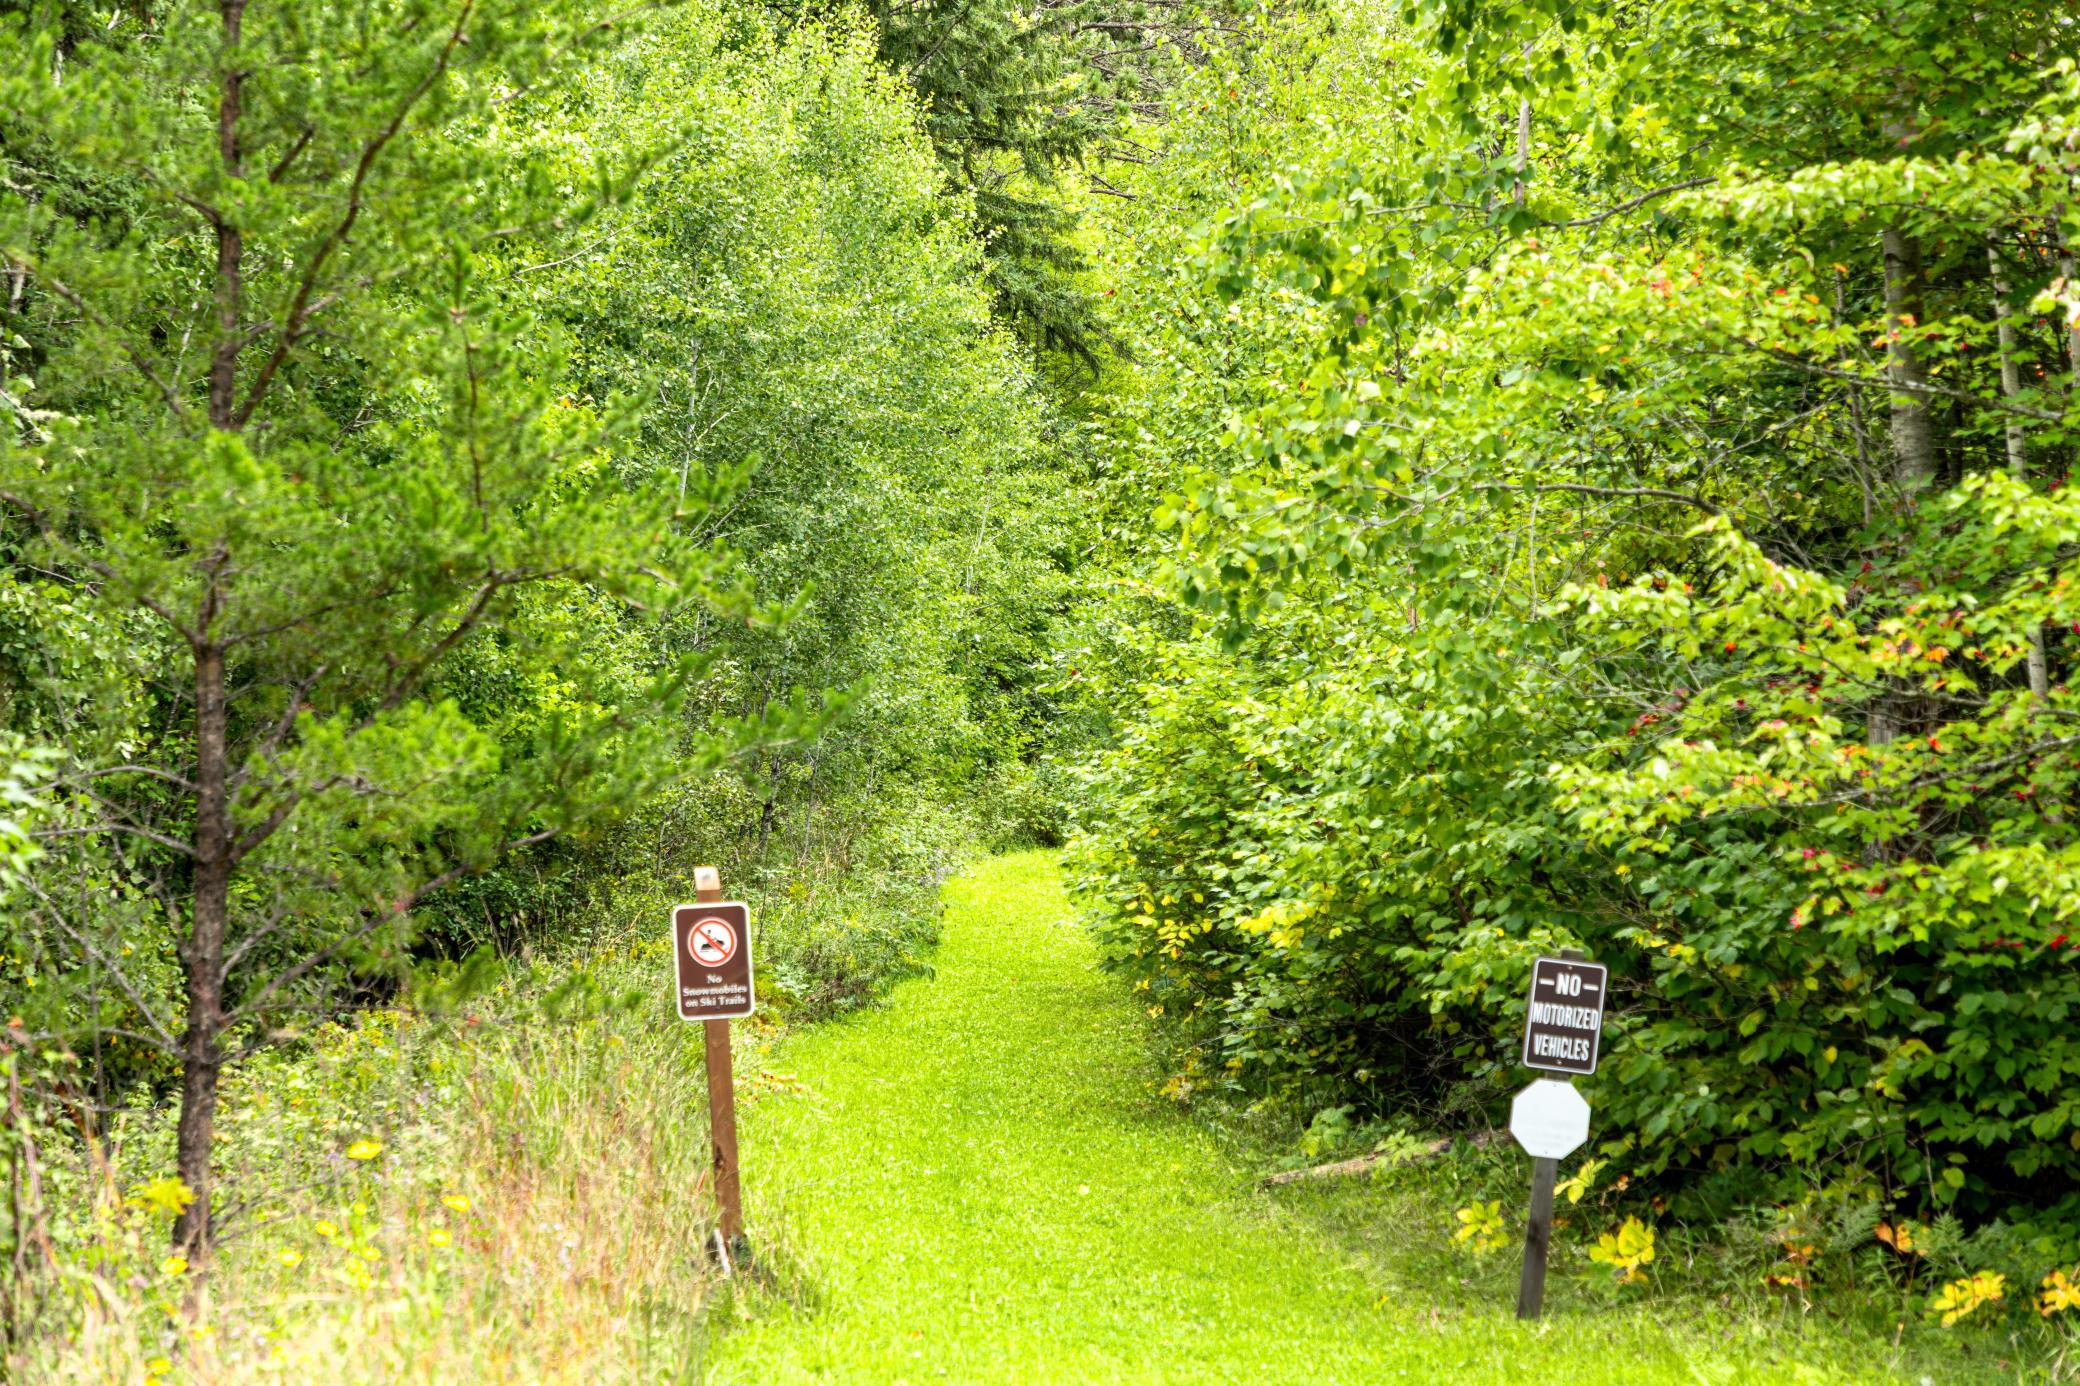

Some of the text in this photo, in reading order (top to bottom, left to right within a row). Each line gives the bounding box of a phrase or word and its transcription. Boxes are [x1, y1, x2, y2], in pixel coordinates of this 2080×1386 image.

[707, 974, 723, 984] No
[1555, 972, 1582, 997] NO
[683, 983, 748, 997] Snowmobiles
[685, 995, 747, 1008] on Ski Trails
[1532, 1001, 1599, 1031] MOTORIZED
[1533, 1034, 1590, 1061] VEHICLES
